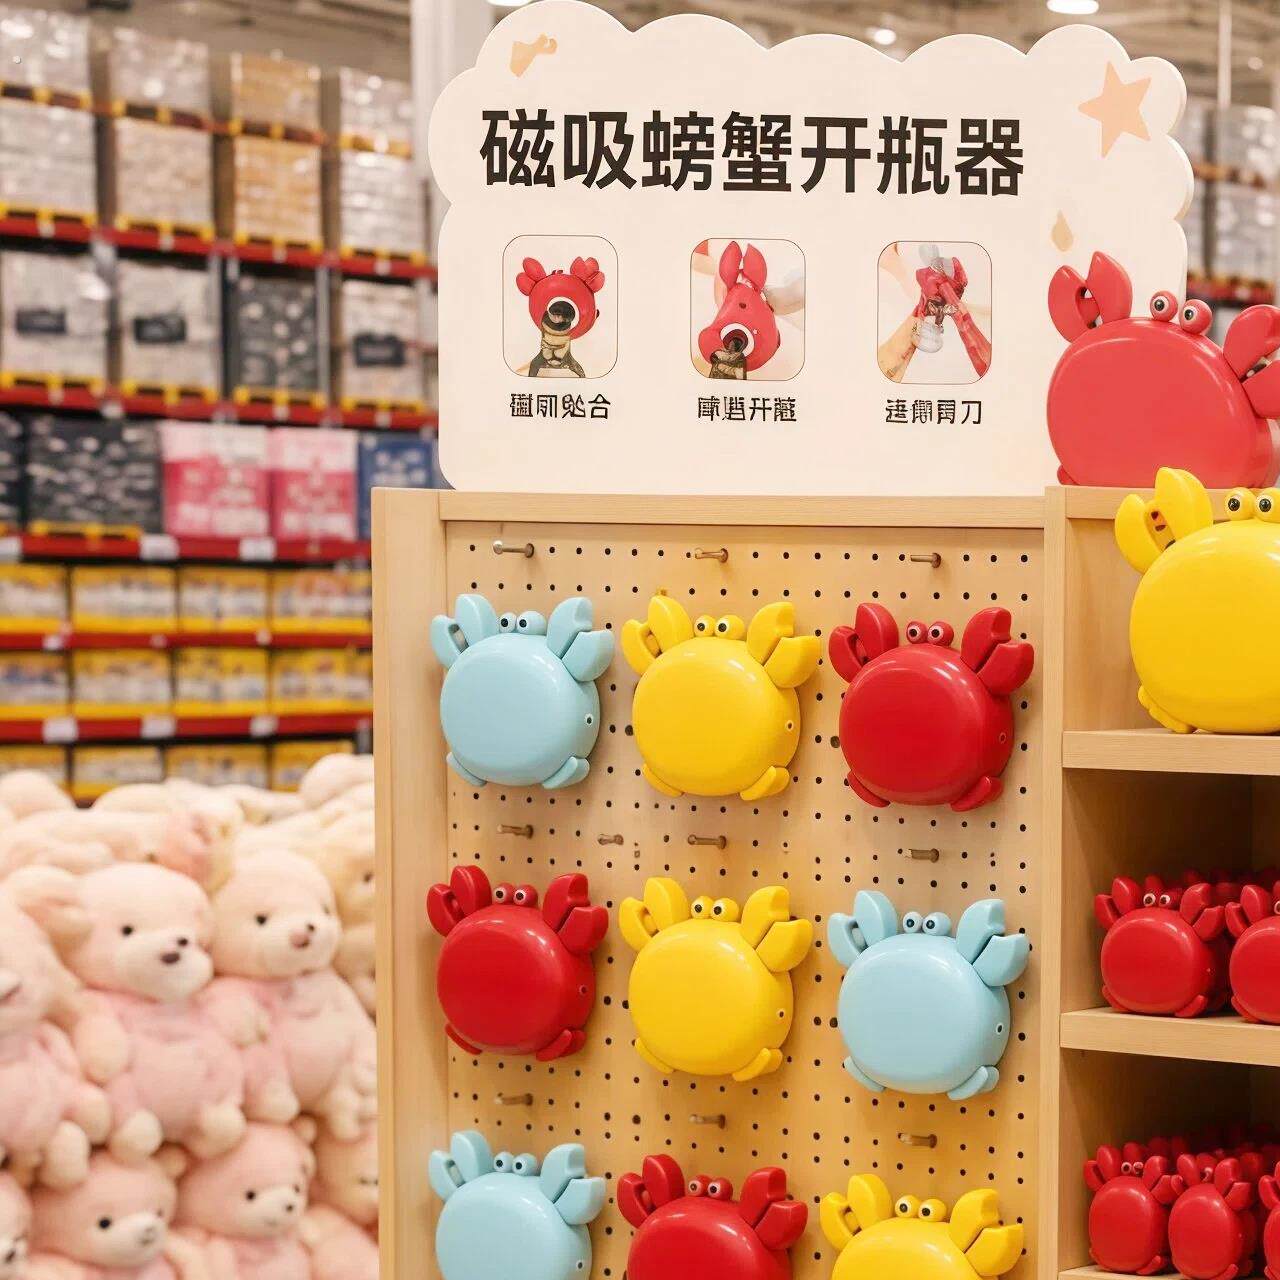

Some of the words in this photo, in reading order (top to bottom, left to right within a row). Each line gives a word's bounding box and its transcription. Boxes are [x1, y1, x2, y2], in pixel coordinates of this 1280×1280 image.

[479, 108, 1024, 197] 磁吸螃蟹开瓶器
